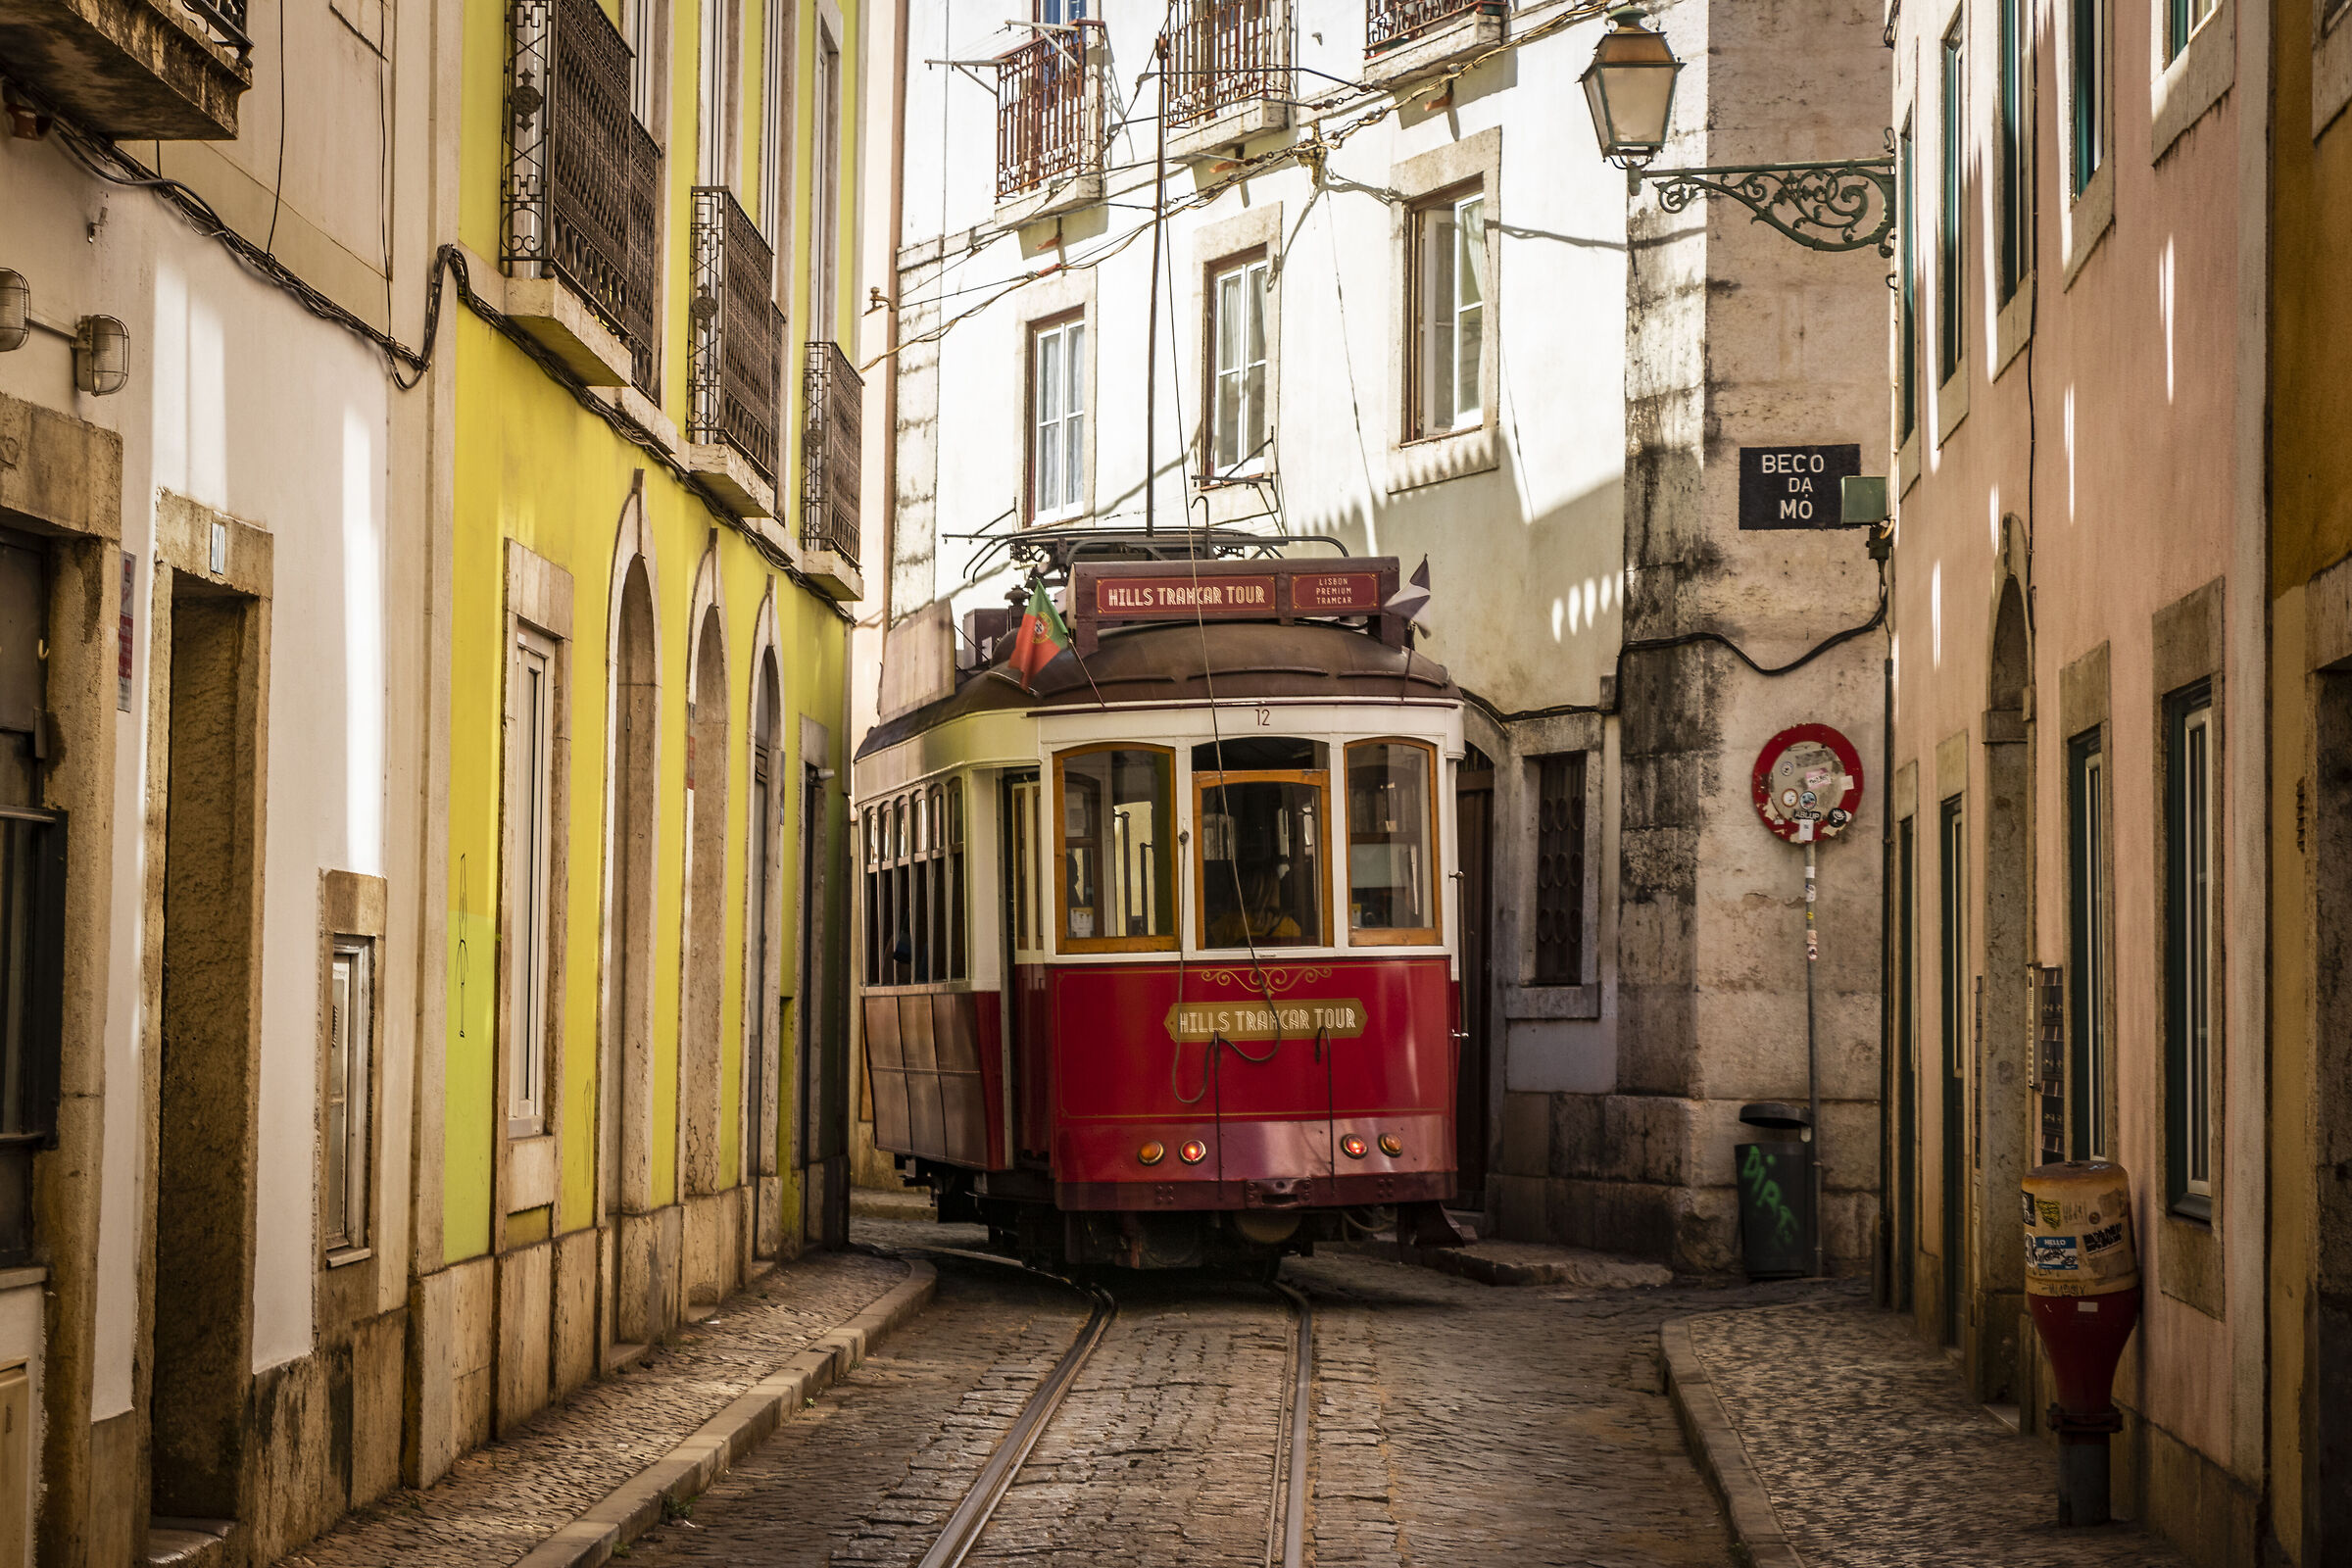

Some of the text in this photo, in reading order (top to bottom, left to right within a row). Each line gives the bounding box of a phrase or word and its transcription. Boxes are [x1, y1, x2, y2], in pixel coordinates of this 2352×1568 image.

[1762, 454, 1825, 473] BECO
[1788, 477, 1813, 492] DA
[1108, 585, 1266, 607] HILLS TRAMCAR TOUR
[1254, 709, 1270, 726] 12
[1179, 1007, 1356, 1034] HILLS TRAMCAR TOUR
